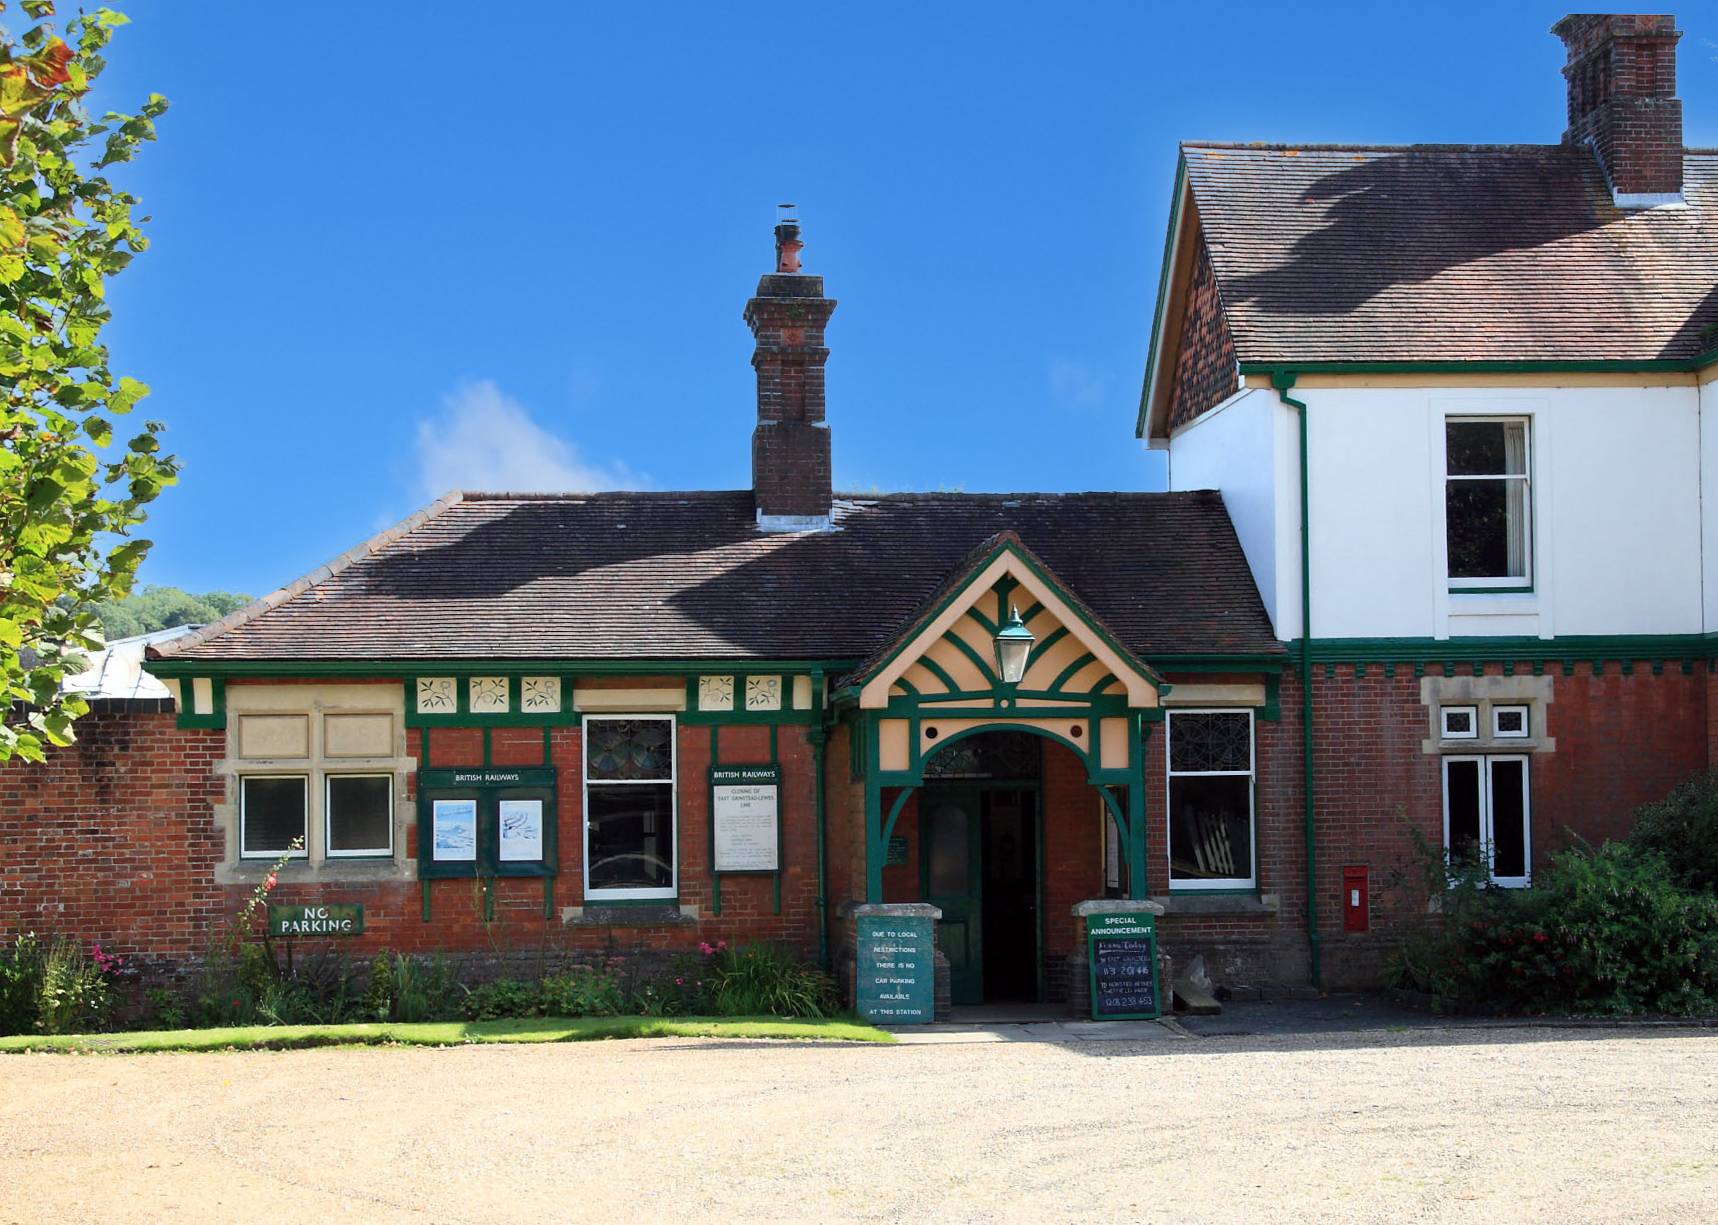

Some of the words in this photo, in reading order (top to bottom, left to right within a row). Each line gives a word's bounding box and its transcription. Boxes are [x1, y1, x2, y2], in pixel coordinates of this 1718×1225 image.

[455, 774, 482, 782] BRITISH
[485, 773, 519, 781] RAILWAYS
[714, 771, 740, 779] BRITISH
[742, 770, 776, 778] RAILWAYS
[1104, 917, 1137, 925] SPECIAL
[281, 919, 352, 933] PARKING
[1090, 926, 1152, 935] ANNOUNCEMENT
